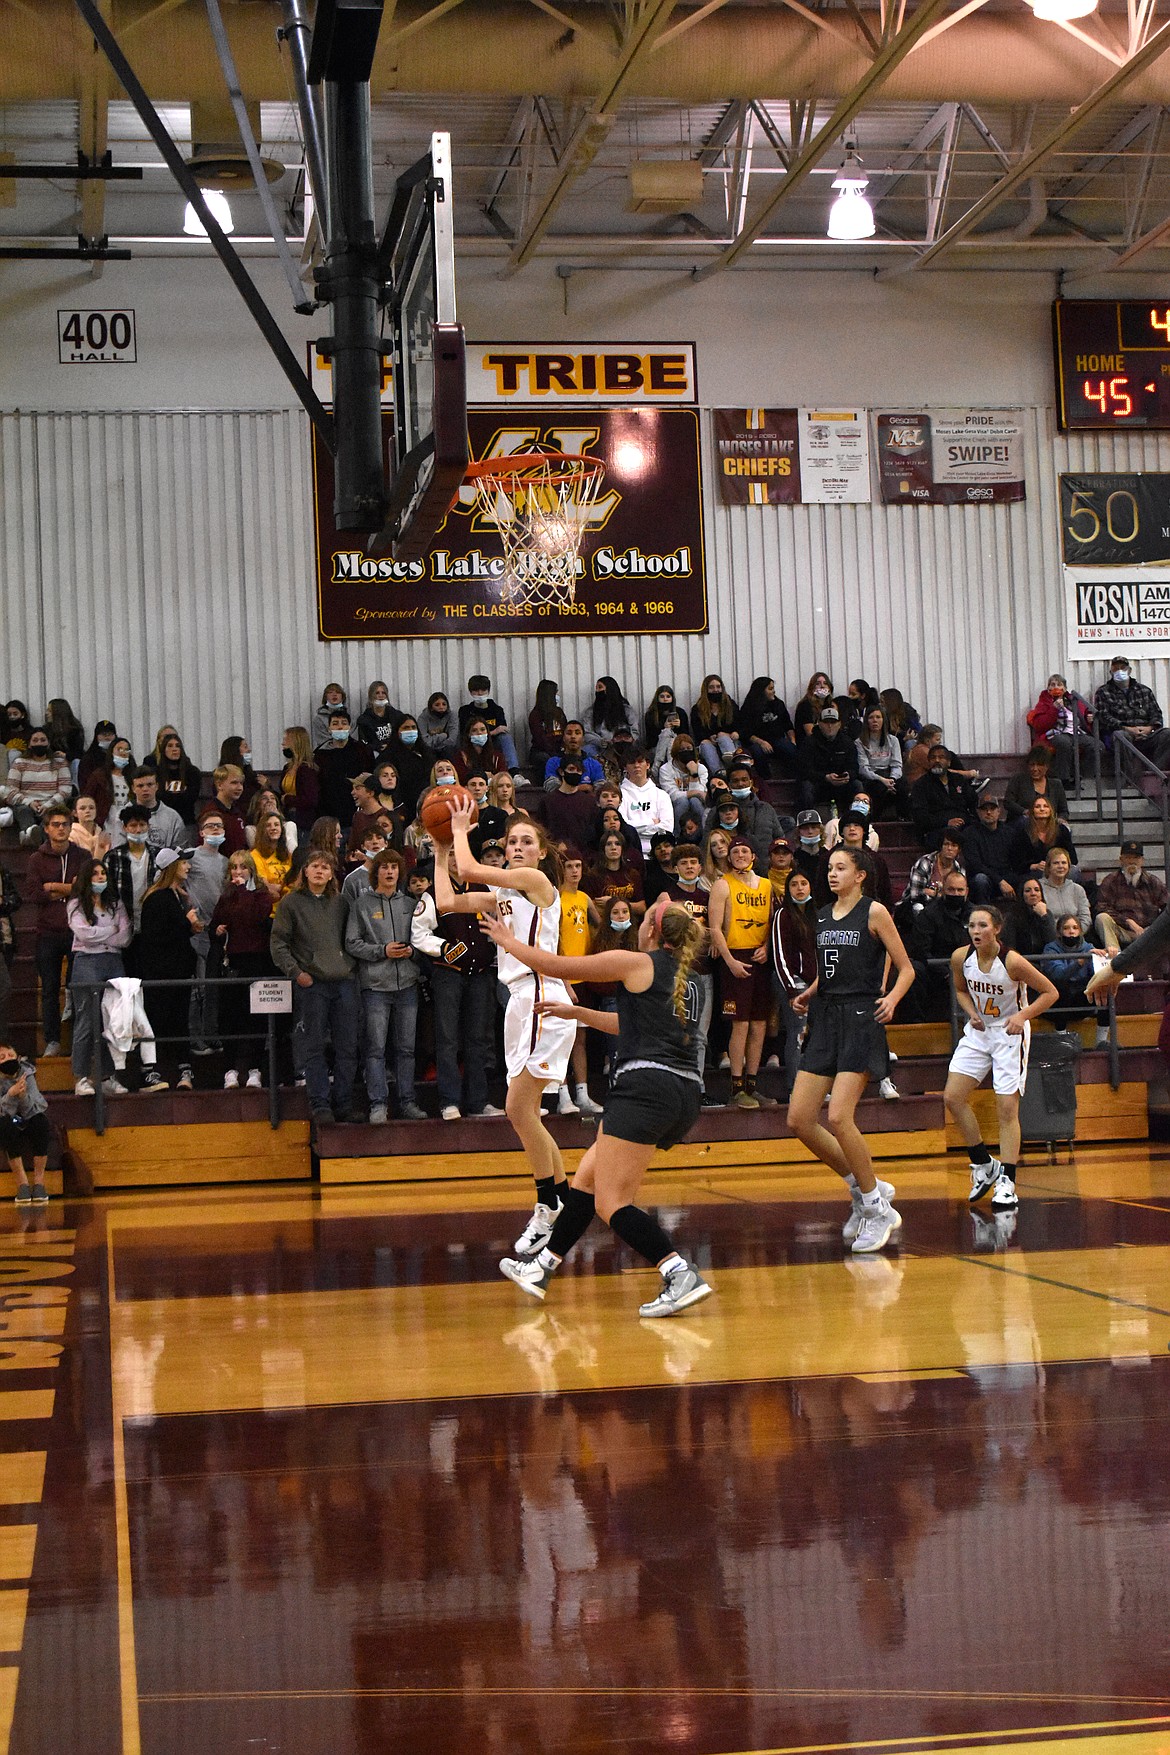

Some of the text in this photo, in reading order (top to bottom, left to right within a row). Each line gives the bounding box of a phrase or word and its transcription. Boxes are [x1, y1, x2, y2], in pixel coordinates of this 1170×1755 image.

[62, 313, 132, 350] 400
[70, 352, 124, 361] HALL
[1076, 354, 1125, 372] HOME
[483, 353, 689, 395] TRIBE
[1084, 378, 1131, 416] 45
[966, 416, 994, 425] PRIDE
[719, 440, 761, 454] MOSES
[765, 440, 794, 454] LAKE
[948, 446, 1009, 462] SWIPE!
[724, 458, 791, 476] CHIEFS
[967, 487, 993, 496] Gesa
[1068, 490, 1139, 543] 50
[333, 552, 425, 582] Moses
[430, 550, 506, 582] Lake
[592, 547, 692, 580] School
[1144, 588, 1170, 600] AM
[354, 607, 418, 621] Sponsored
[422, 607, 438, 621] by
[443, 604, 468, 617] THE
[473, 603, 533, 617] CLASSES
[538, 603, 551, 616] of
[594, 602, 624, 615] 1964
[630, 604, 638, 614] &
[644, 601, 674, 614] 1966
[1079, 585, 1138, 623] KBSN
[1078, 629, 1102, 638] NEWS
[1115, 628, 1135, 637] TALK
[736, 892, 766, 907] Chiefs
[446, 943, 465, 962] 2022
[825, 950, 839, 978] 5
[968, 980, 1004, 995] CHIEFS
